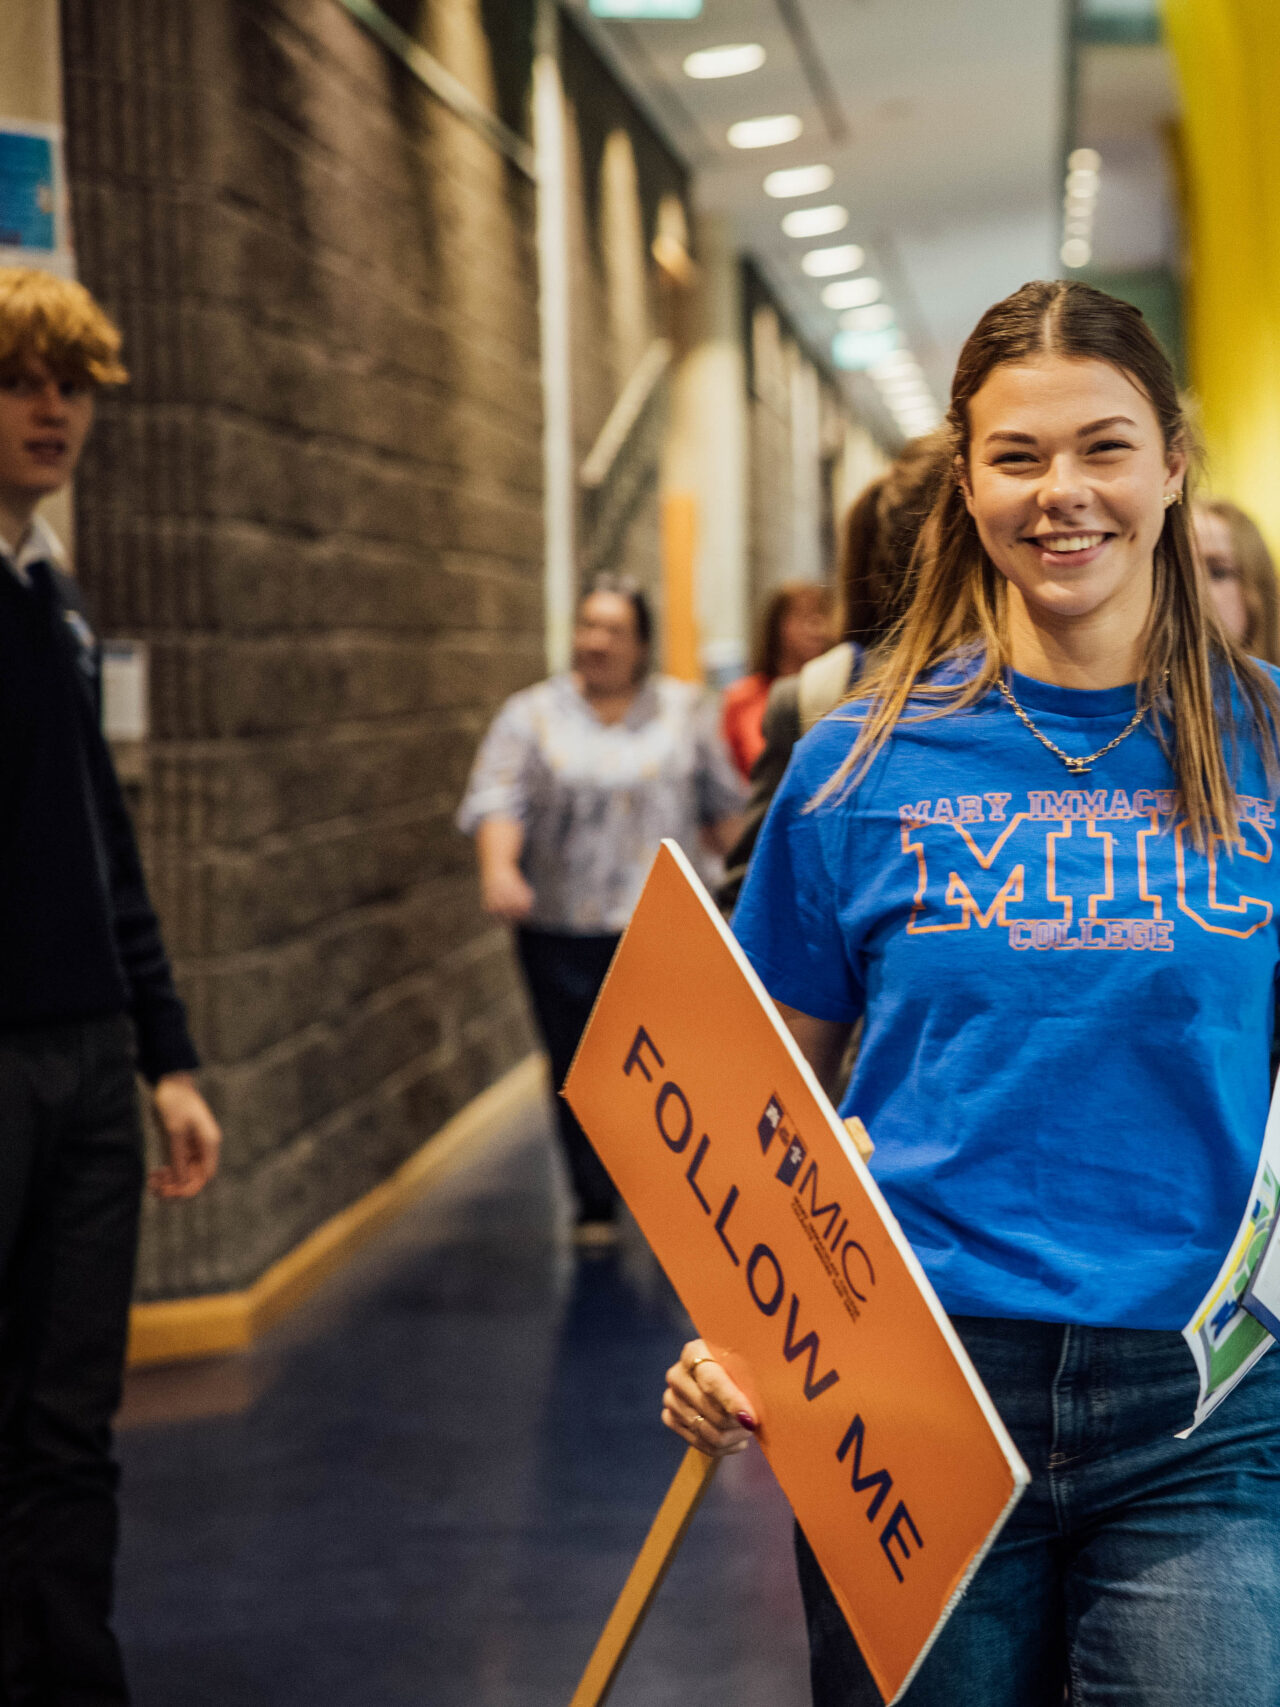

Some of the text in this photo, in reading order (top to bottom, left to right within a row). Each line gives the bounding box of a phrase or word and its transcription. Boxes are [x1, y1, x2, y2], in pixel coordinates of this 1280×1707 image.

[899, 789, 1275, 832] MARY IMMACUTE
[901, 813, 1273, 939] MIC
[1008, 918, 1175, 952] COLLEGE
[798, 1159, 876, 1303] MIC
[622, 1024, 840, 1402] FOLLOW
[835, 1413, 924, 1584] ME
